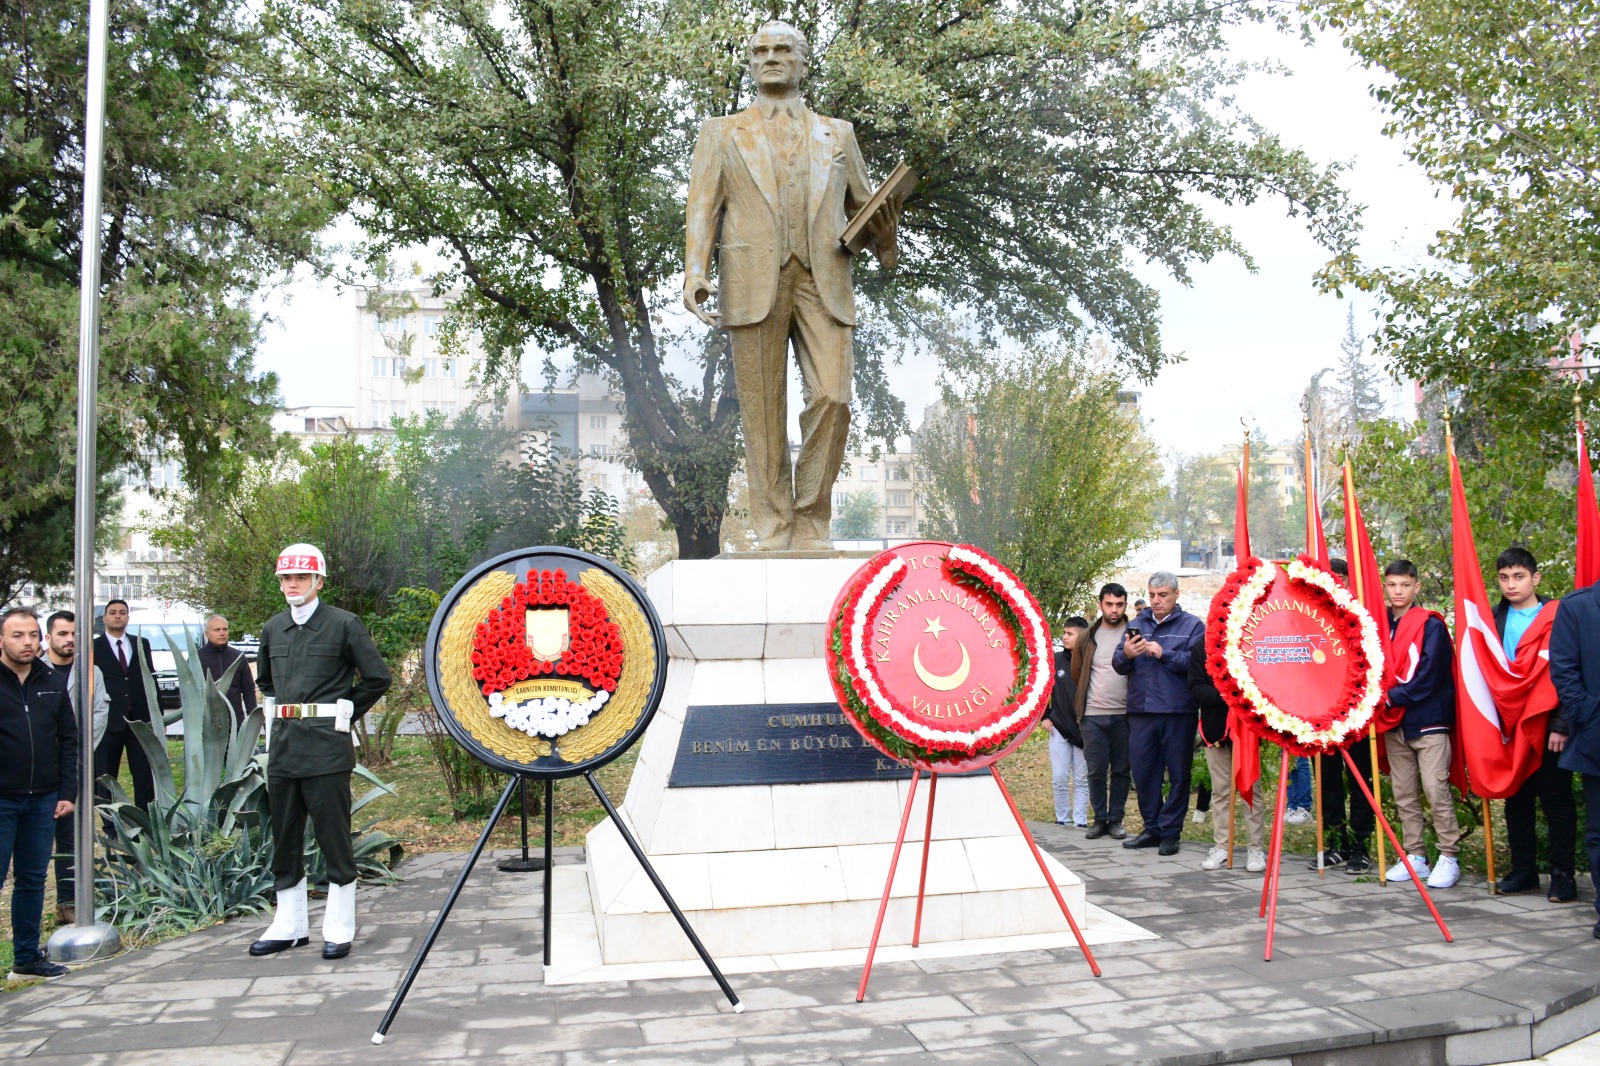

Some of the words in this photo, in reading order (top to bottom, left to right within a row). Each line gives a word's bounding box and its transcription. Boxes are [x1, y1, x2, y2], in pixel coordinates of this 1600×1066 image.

[907, 555, 939, 571] T.C.
[877, 587, 1003, 663] KAHRAMANMARAŞ
[912, 682, 994, 719] VALİLİĞİ
[767, 713, 850, 728] CUMHUR
[691, 738, 750, 754] BENİM
[757, 740, 781, 752] EN
[790, 734, 852, 751] BÜYÜK
[876, 758, 891, 770] K.
